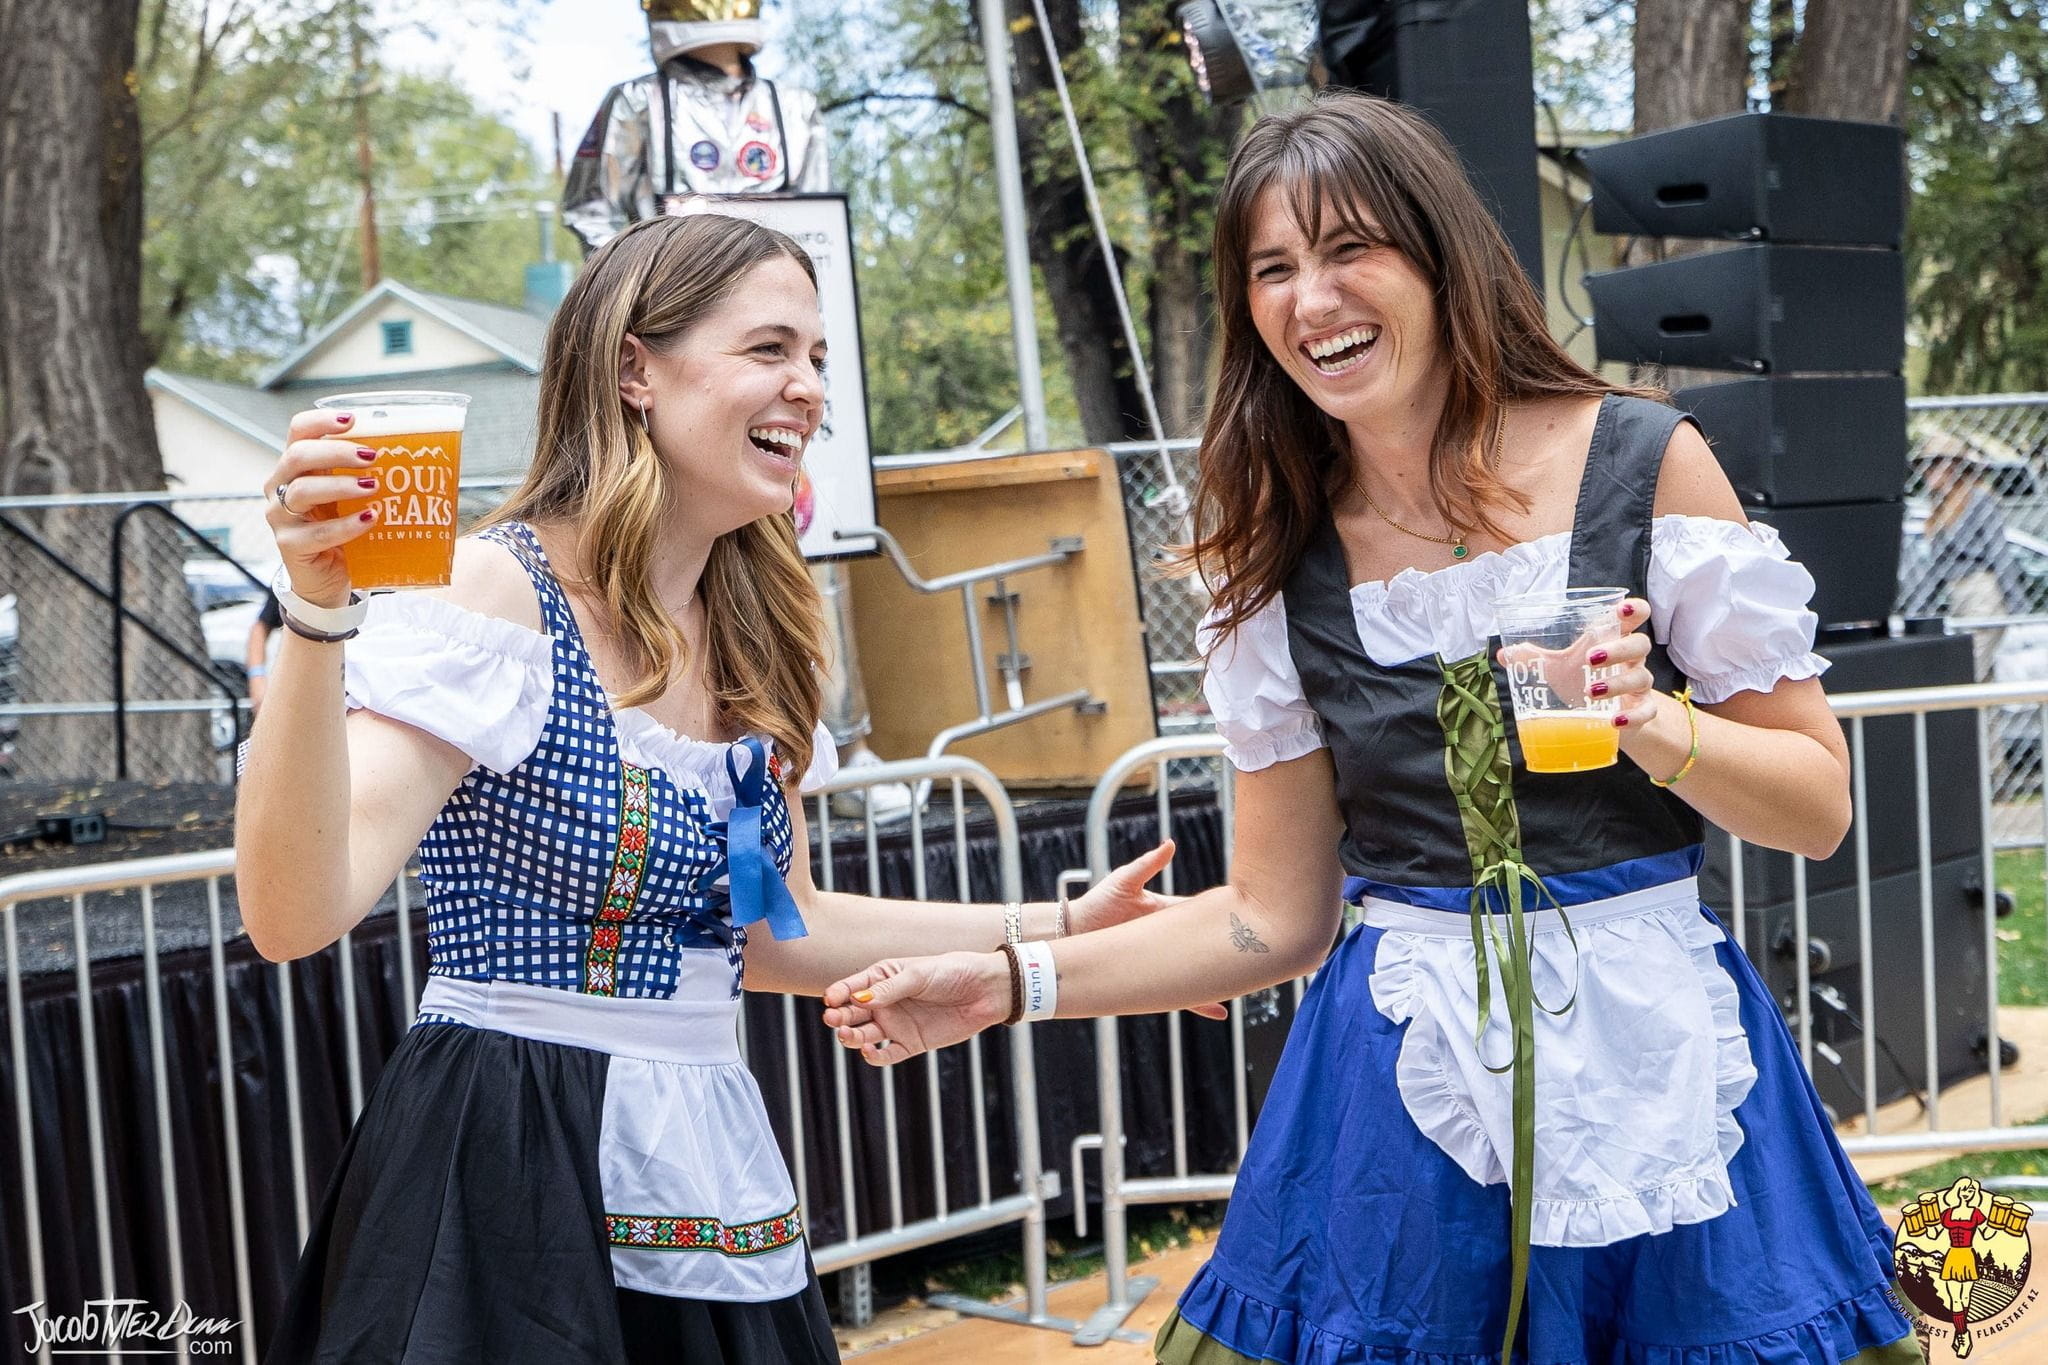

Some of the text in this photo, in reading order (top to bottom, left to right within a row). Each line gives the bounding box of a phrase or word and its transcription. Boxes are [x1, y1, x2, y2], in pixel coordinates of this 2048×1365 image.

[366, 494, 452, 526] PEAKS
[369, 530, 432, 540] BREWING
[1031, 971, 1041, 1011] ULTRA
